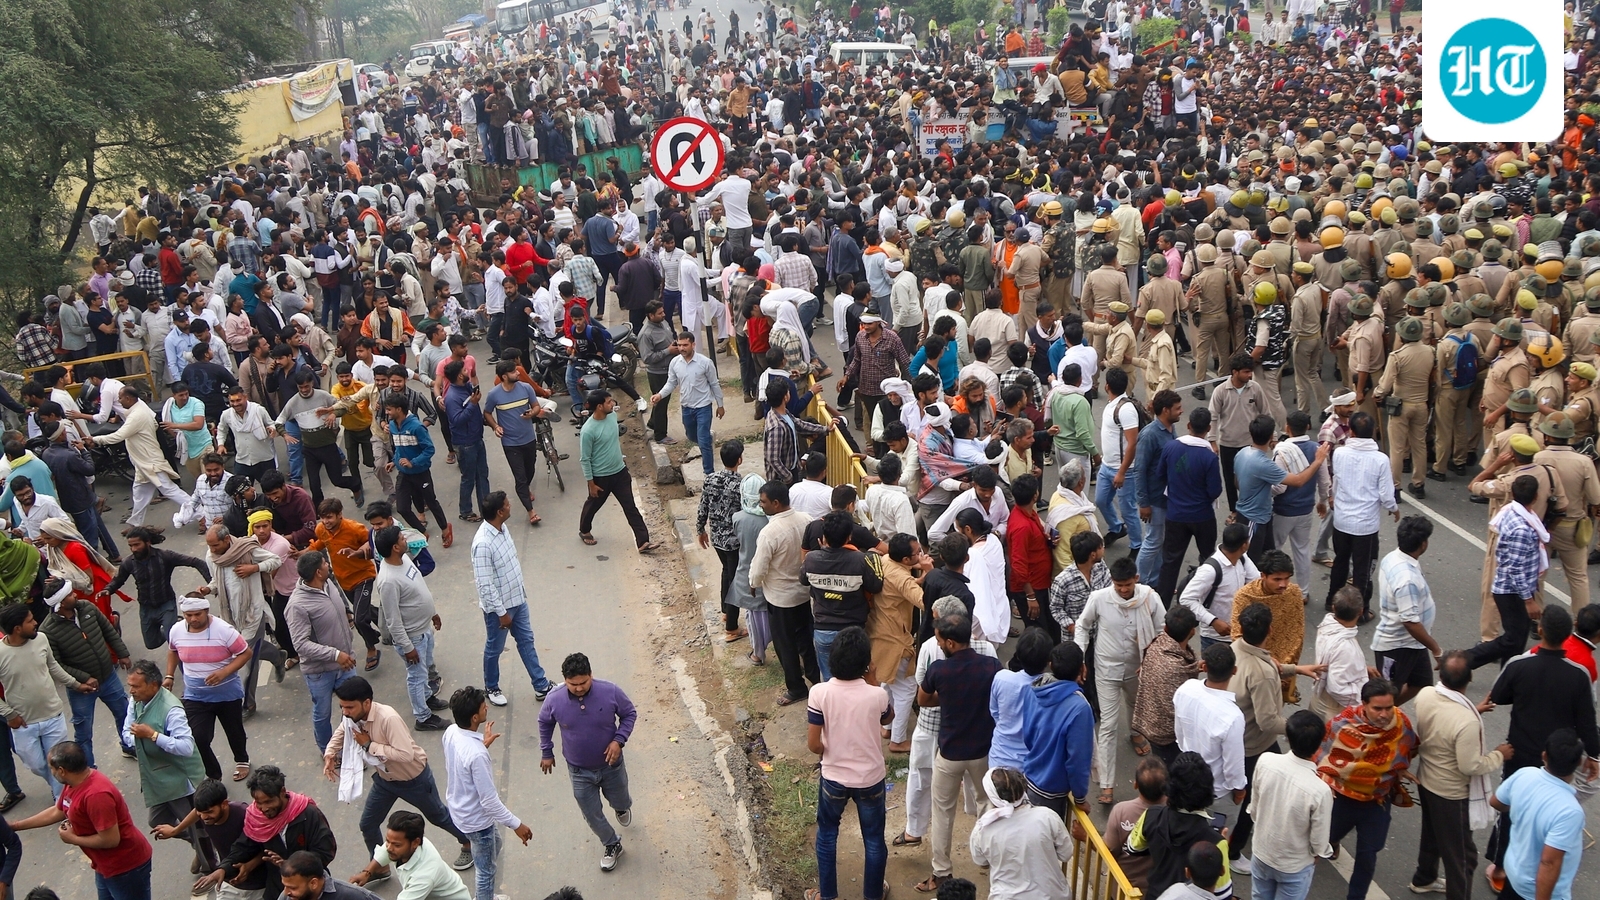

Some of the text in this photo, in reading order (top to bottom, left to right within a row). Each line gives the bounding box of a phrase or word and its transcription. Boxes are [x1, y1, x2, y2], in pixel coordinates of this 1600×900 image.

[935, 124, 957, 136] रक्षक
[818, 577, 848, 587] FOR NOW
